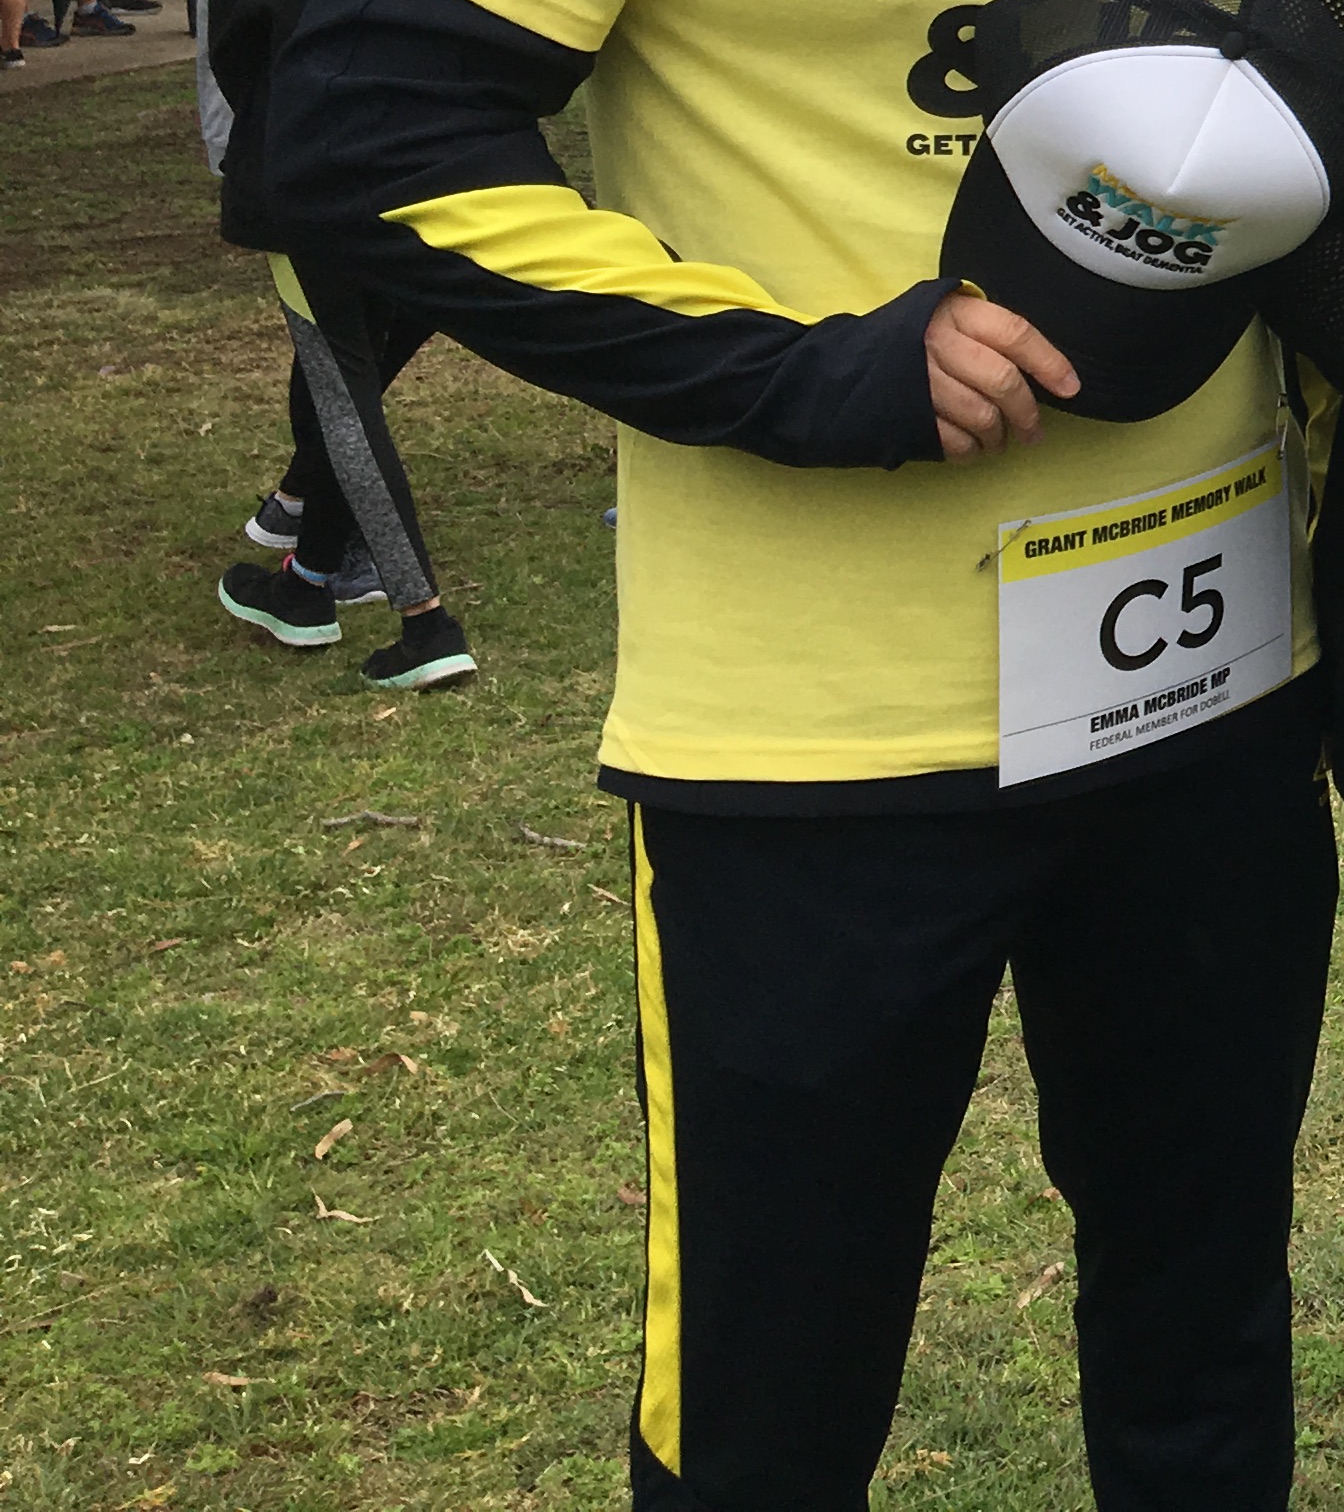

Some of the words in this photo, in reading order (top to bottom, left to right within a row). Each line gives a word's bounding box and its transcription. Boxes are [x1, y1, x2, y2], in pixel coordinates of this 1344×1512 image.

[905, 133, 978, 157] GET
[1066, 191, 1105, 227] &
[1105, 217, 1214, 266] JOG
[1088, 174, 1226, 246] WALK
[1024, 530, 1087, 559] GRANT
[1091, 510, 1167, 546] MCBRIDE
[1170, 485, 1231, 523] MEMORY
[1234, 466, 1267, 498] WALK
[1099, 552, 1225, 672] C5
[1089, 728, 1133, 751] FEDERAL
[1135, 711, 1179, 738] MEMBER
[1180, 704, 1199, 724] FOR
[1200, 689, 1231, 716] DOBELL
[1090, 703, 1140, 734] EMMA
[1143, 678, 1208, 716] MCBRIDE
[1210, 666, 1231, 690] MP
